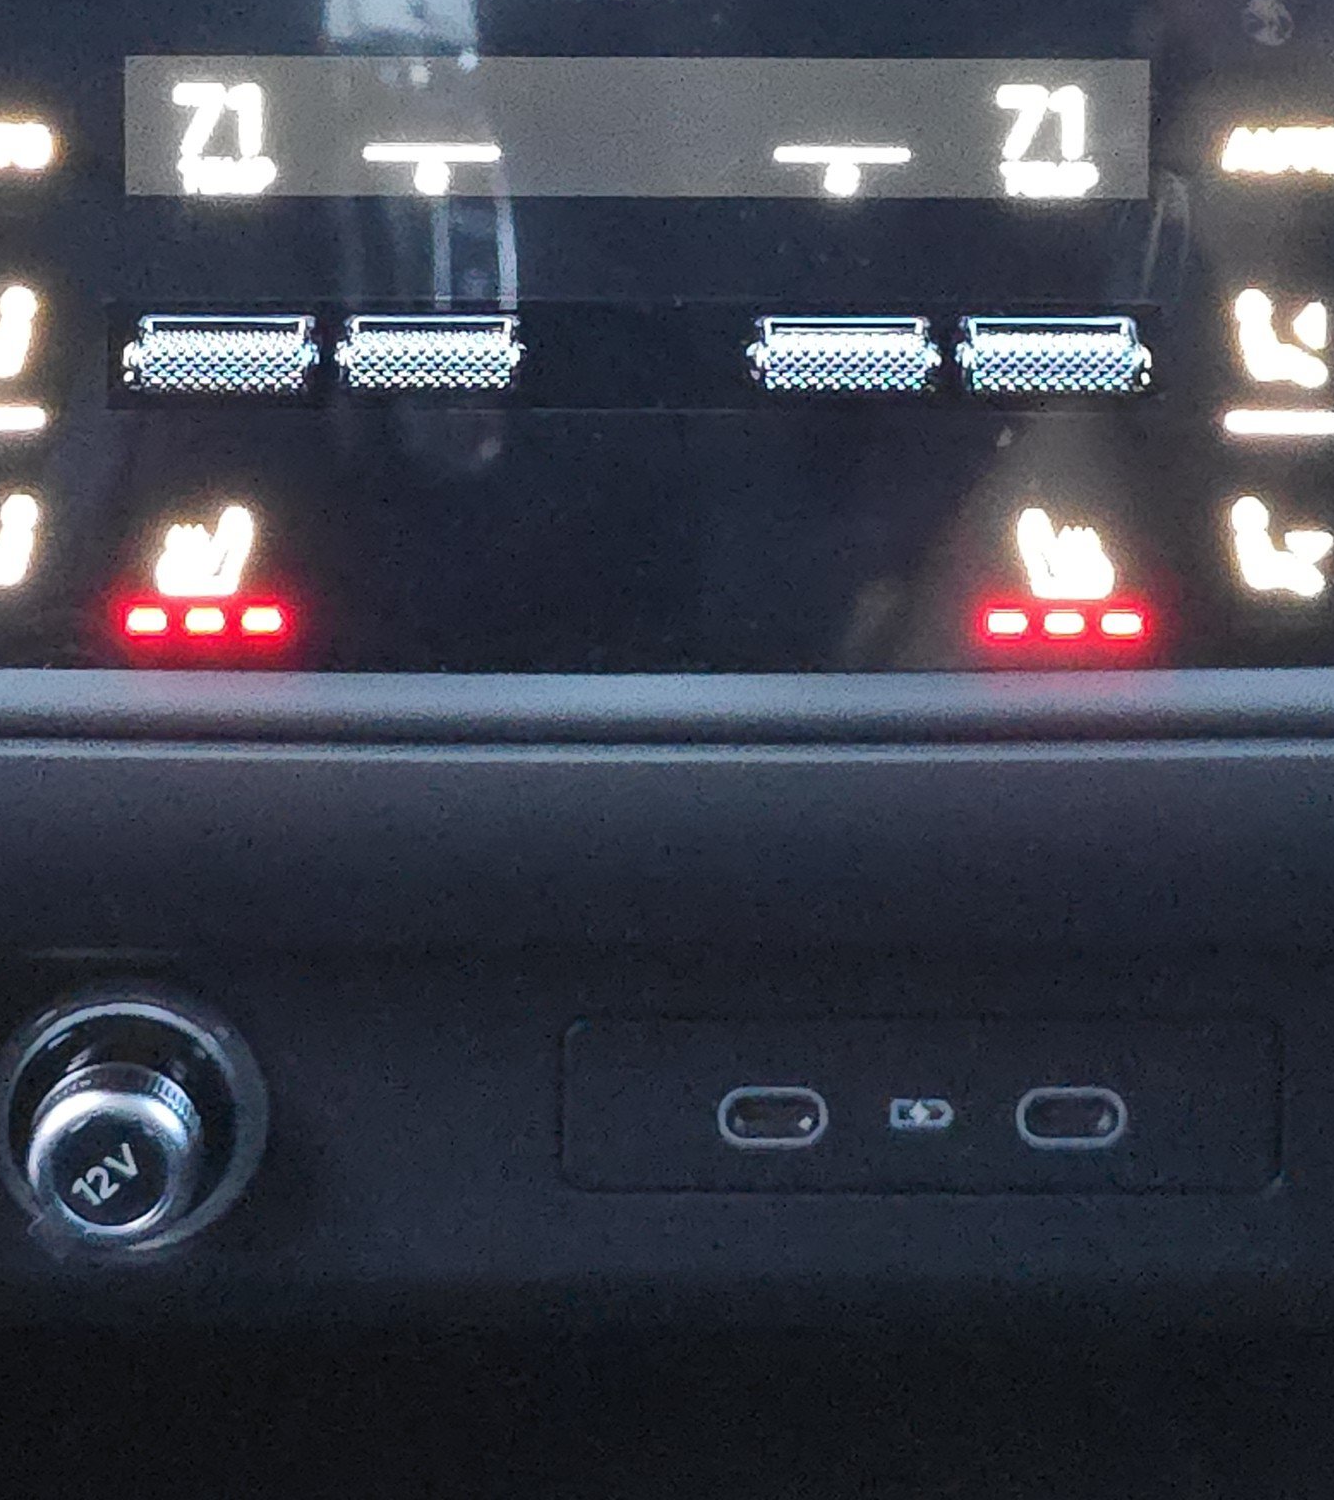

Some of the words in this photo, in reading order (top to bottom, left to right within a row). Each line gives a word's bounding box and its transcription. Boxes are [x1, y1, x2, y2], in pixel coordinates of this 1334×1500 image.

[172, 82, 263, 157] 71
[996, 84, 1086, 160] 71
[71, 1142, 138, 1206] 12V
